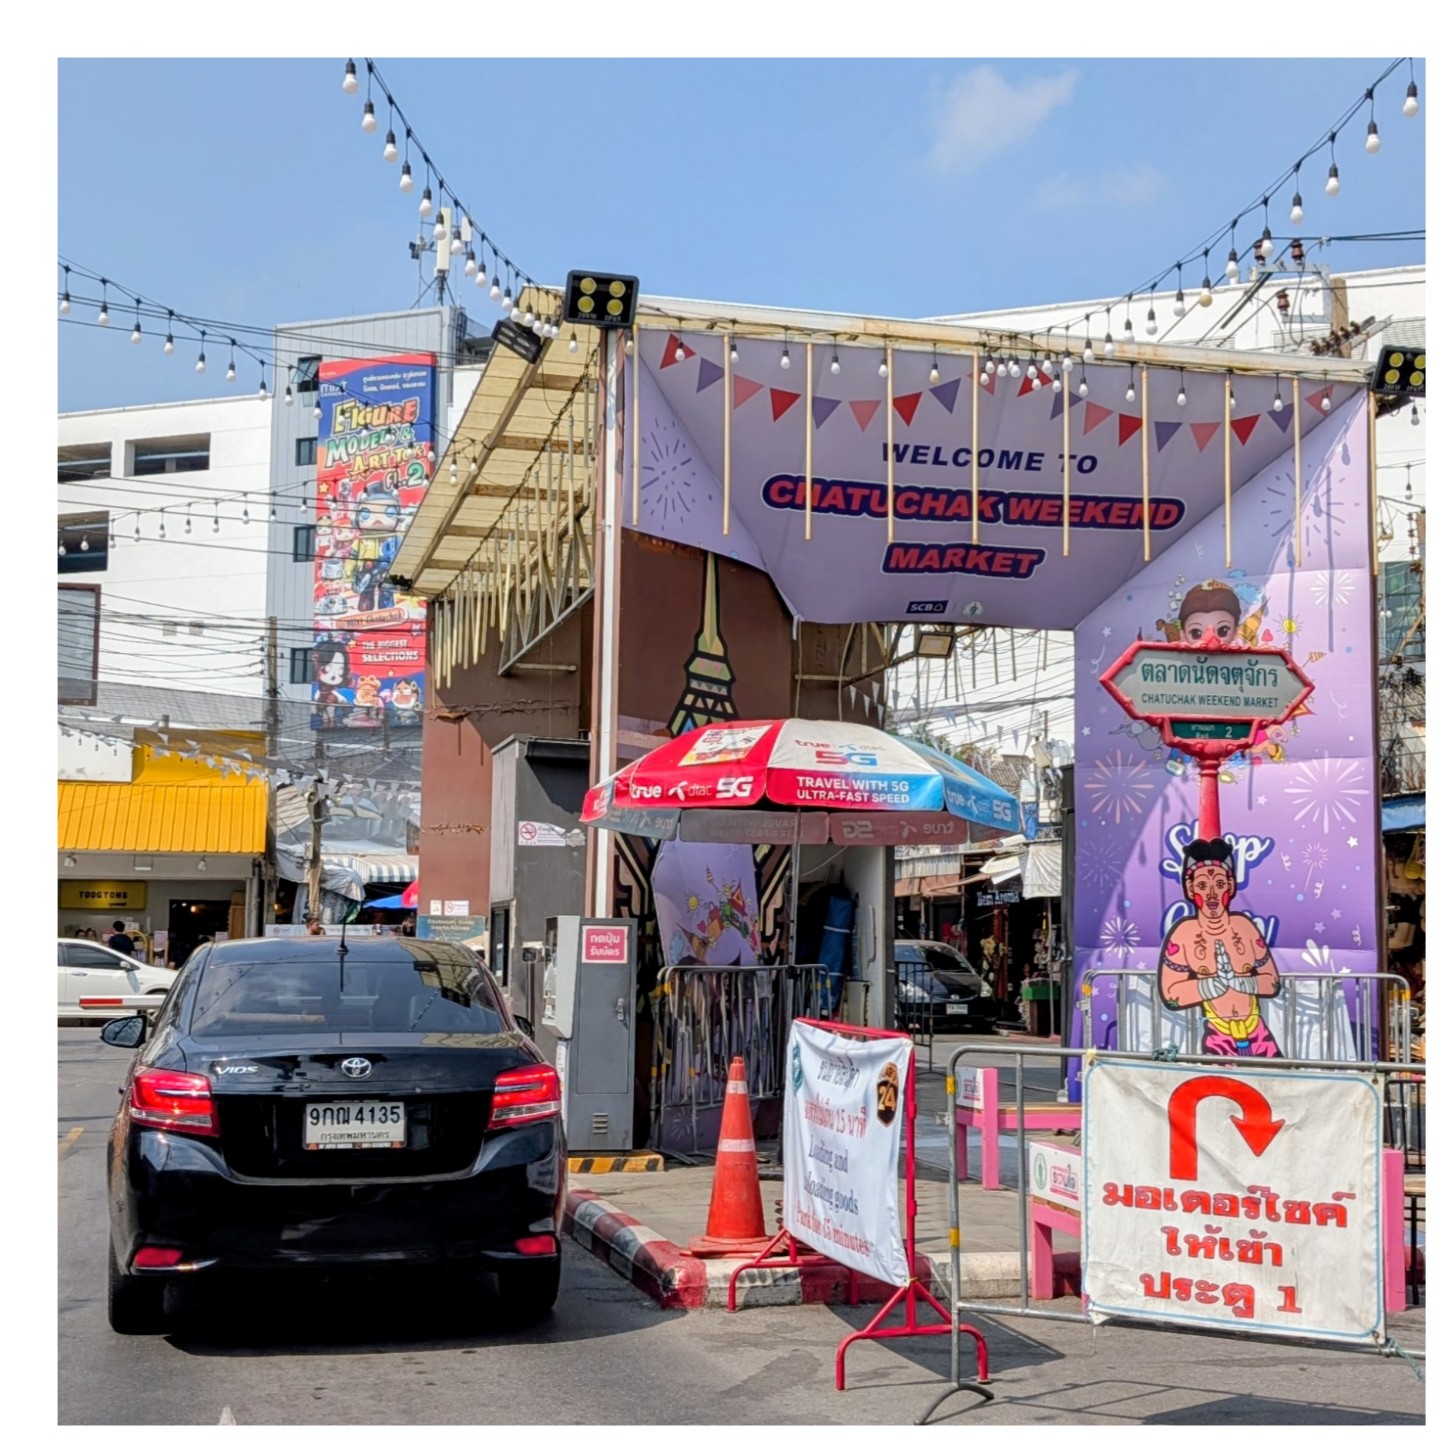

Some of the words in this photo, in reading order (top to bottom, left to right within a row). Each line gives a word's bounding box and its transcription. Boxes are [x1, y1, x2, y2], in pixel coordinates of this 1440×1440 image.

[882, 442, 1046, 472] WELCOME
[1058, 452, 1099, 475] TO
[768, 478, 1001, 520] CHATUCHAK
[1008, 496, 1180, 526] WEEKEND
[888, 547, 1040, 575] MARKET
[909, 603, 934, 612] SCB
[361, 641, 376, 650] THE
[361, 651, 419, 663] SELECTIONS
[1141, 656, 1279, 694] ตลาดนัดจตุจักร
[1141, 693, 1198, 706] CHATUCHAK
[1198, 694, 1242, 707] WEEKEND
[1243, 696, 1279, 708] MARKET
[1225, 726, 1233, 738] 2
[795, 739, 831, 750] true
[815, 751, 878, 767] 5G
[631, 783, 662, 799] true
[688, 783, 713, 797] dtac
[716, 775, 754, 799] 5G
[796, 776, 849, 791] TRAVEL
[852, 779, 888, 793] WITH
[891, 780, 909, 793] 5G
[797, 790, 869, 803] ULTRA-FAST
[872, 792, 910, 804] SPEED
[590, 931, 620, 946] กดปุ่ม
[590, 945, 620, 956] รับบัตร
[215, 1065, 259, 1076] VIOS
[878, 1085, 897, 1112] 24
[354, 1105, 401, 1125] 4135
[320, 1130, 390, 1142] กรุงเทพมหานคร
[834, 1188, 859, 1216] goods
[833, 1223, 871, 1258] minutes
[1161, 1224, 1284, 1267] ให้เข้า
[1139, 1271, 1256, 1319] ประตู
[1277, 1285, 1303, 1314] 1
